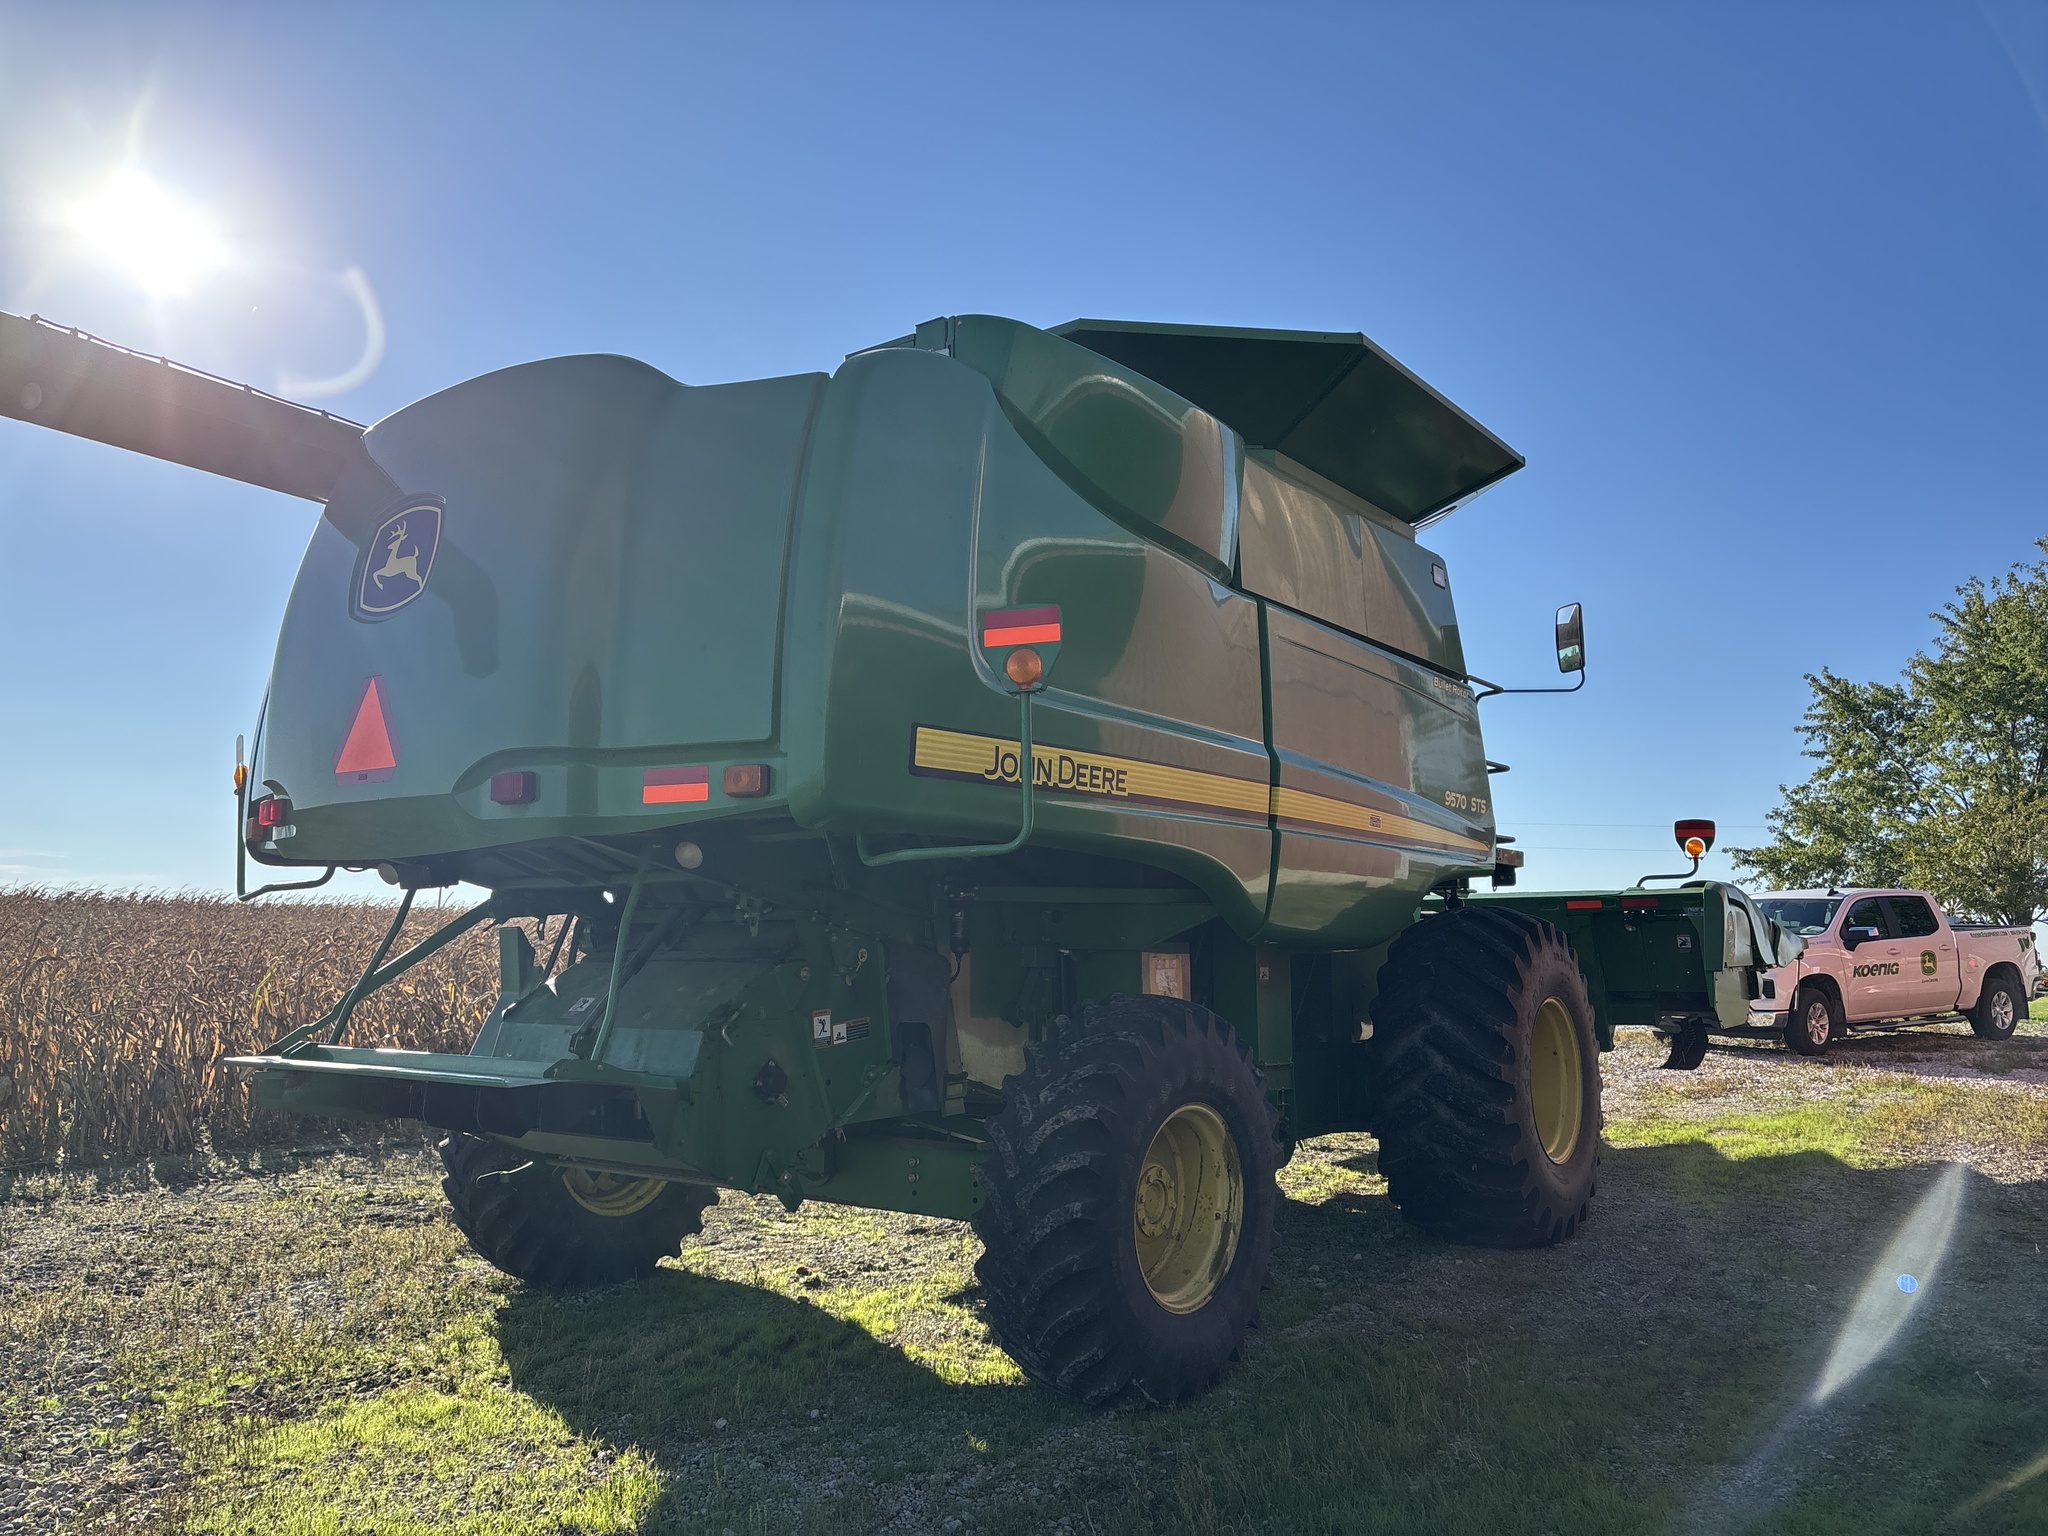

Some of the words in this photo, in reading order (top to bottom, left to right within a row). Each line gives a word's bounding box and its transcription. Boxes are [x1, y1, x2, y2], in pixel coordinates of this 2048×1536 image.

[1433, 676, 1452, 692] Bullet
[1452, 684, 1470, 698] Rotor
[1058, 754, 1128, 793] DEERE
[1444, 790, 1467, 810] 9570
[1470, 797, 1487, 814] STS
